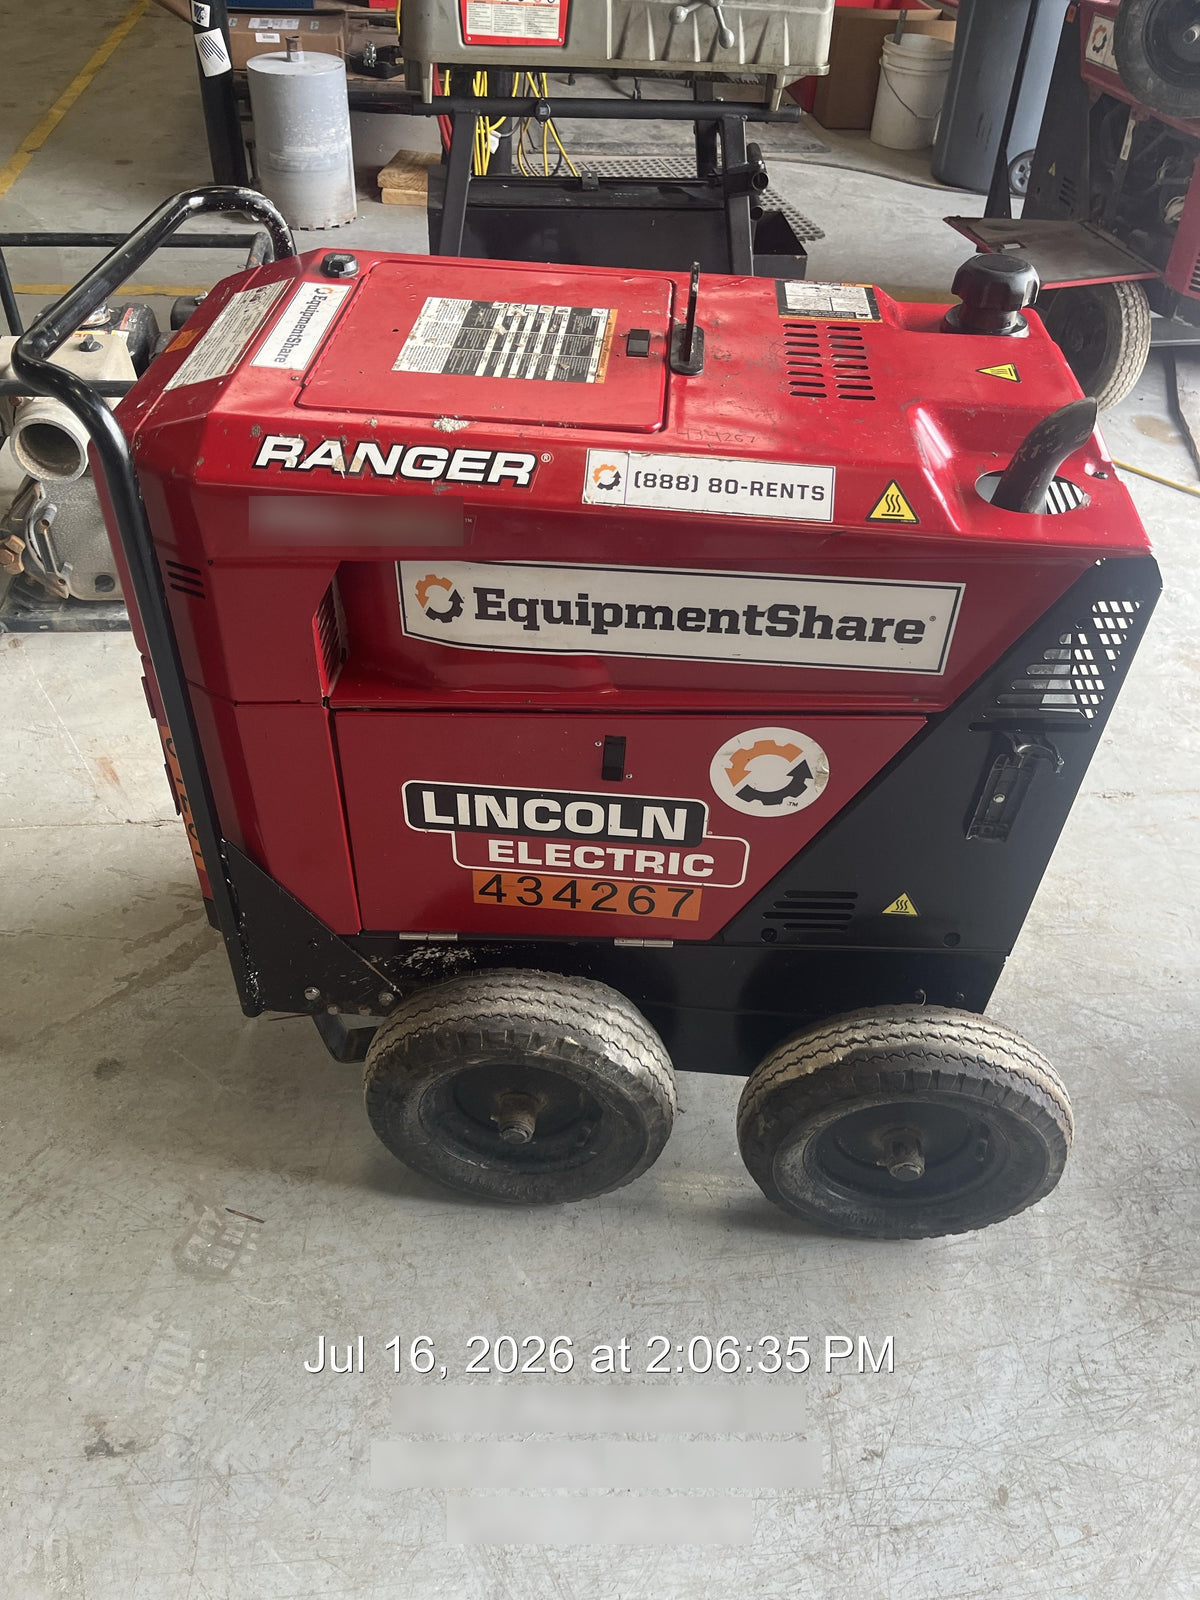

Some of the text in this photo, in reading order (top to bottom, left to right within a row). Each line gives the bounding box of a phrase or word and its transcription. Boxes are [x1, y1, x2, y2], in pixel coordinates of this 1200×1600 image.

[274, 295, 328, 364] EquipmentShare
[634, 470, 825, 501] (888) 80-RENTS
[421, 790, 688, 841] LINCOLN
[488, 839, 714, 877] ELECTRIC
[478, 873, 695, 918] 434267
